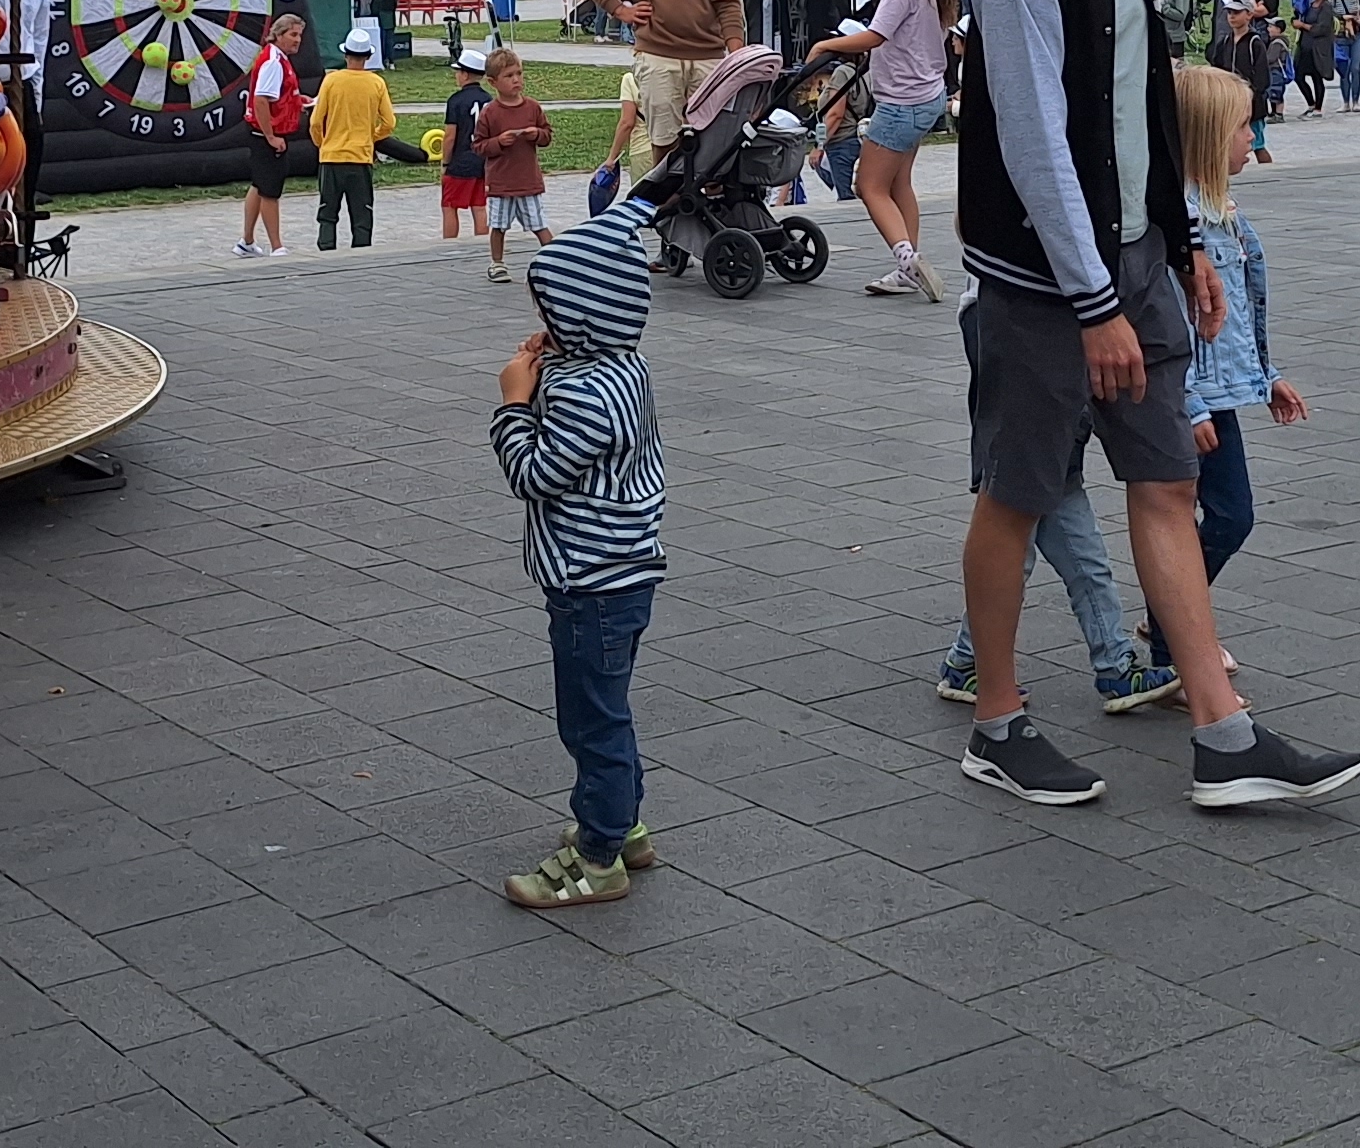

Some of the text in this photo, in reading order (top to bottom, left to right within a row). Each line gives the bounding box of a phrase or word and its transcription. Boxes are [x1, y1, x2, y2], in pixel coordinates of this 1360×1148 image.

[52, 42, 70, 57] 8
[66, 72, 90, 98] 16
[98, 100, 116, 118] 7
[130, 114, 153, 134] 19
[173, 118, 185, 137] 3
[203, 108, 224, 131] 17
